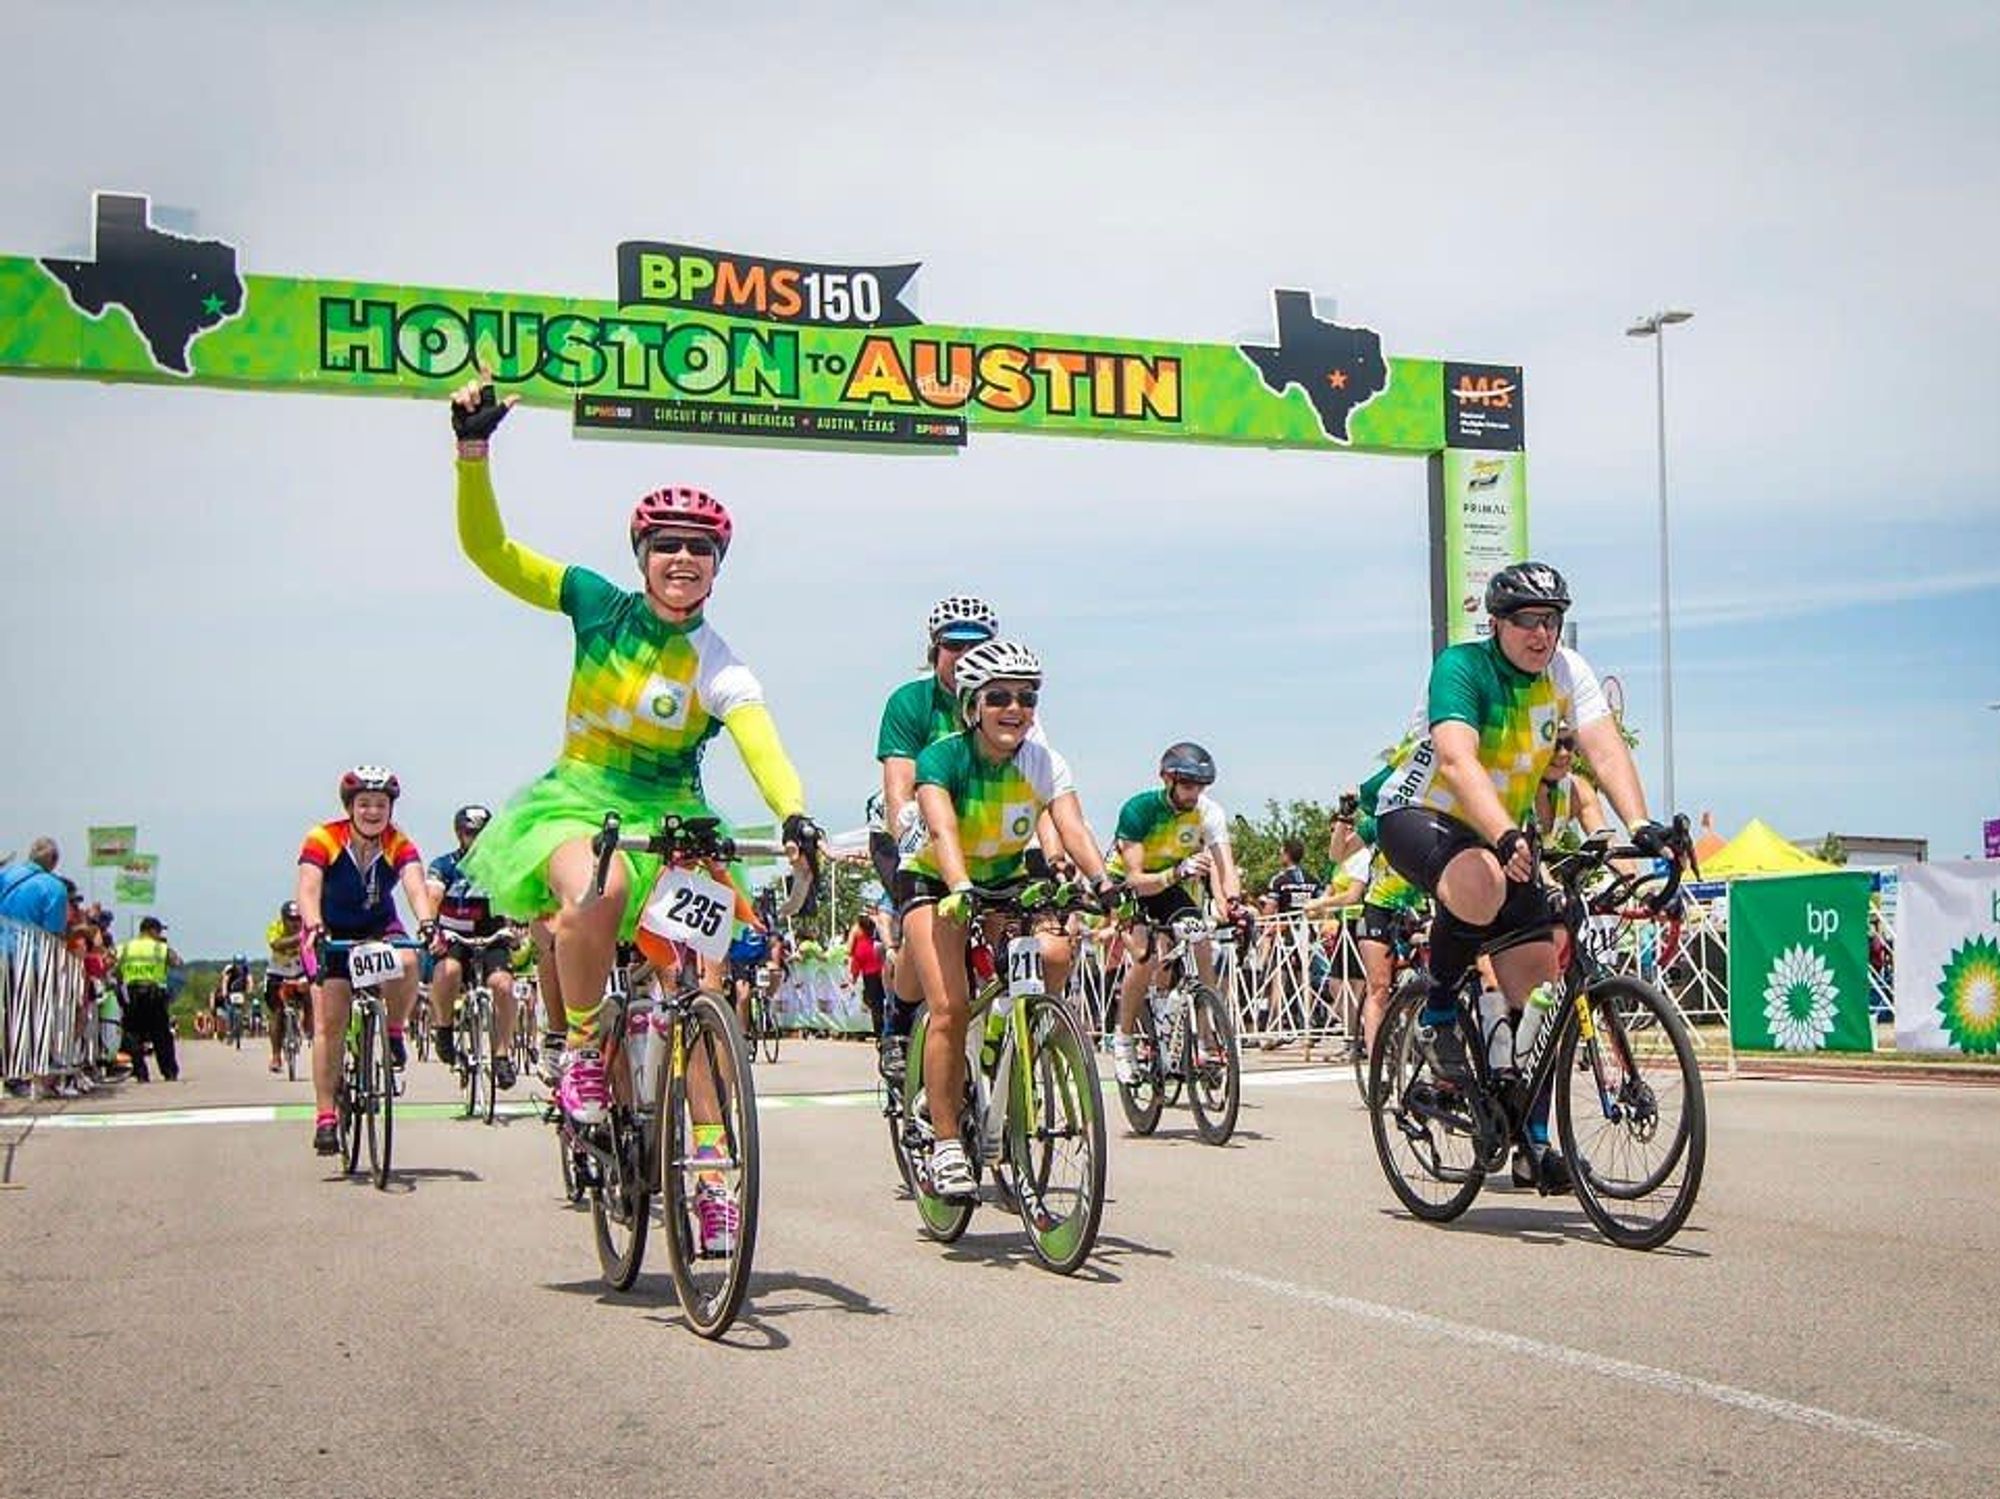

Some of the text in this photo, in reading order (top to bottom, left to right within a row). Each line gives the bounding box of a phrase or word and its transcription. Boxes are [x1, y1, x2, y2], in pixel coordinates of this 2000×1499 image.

[640, 253, 880, 322] BPMS150
[319, 296, 1182, 423] HOUSTON TO AUSTIN
[655, 407, 795, 428] CIRCUIT OF THE AMERICAS
[863, 419, 895, 433] TEXAS
[666, 888, 727, 936] 235
[1807, 902, 1839, 941] bp
[353, 950, 395, 977] 8470
